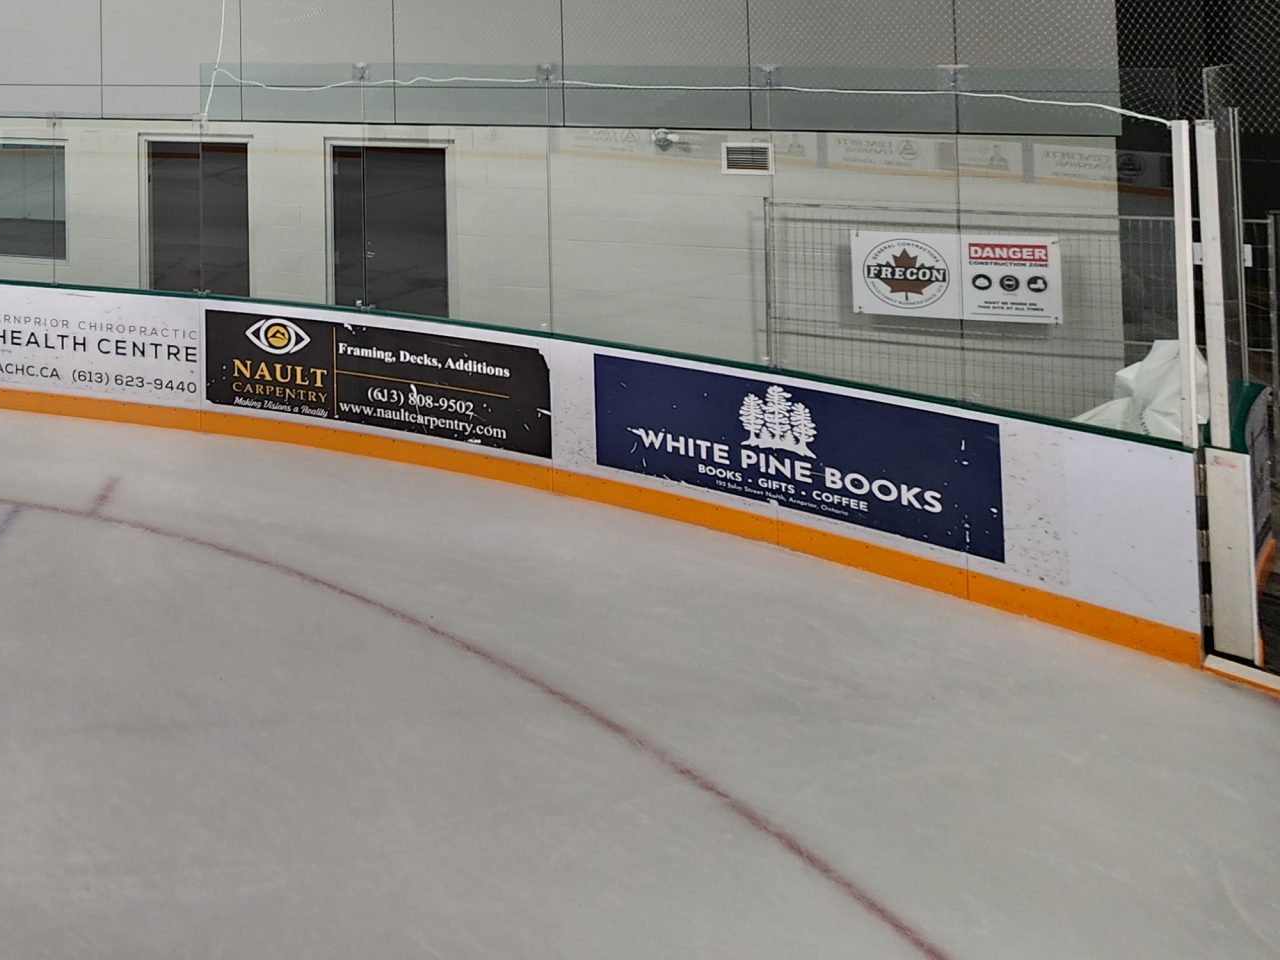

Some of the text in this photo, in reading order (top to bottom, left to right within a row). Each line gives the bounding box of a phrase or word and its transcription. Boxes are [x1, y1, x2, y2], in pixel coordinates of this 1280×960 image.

[970, 246, 1047, 260] DANGER
[869, 266, 945, 282] FRECON
[78, 320, 198, 341] CHIROPRACTIC
[97, 338, 198, 363] CENTRE
[338, 343, 510, 378] Framing, Decks, Additions
[71, 369, 110, 386] (613)
[114, 373, 197, 394] 623-9440
[232, 359, 328, 388] NAULT
[232, 381, 329, 404] CARPENTRY
[367, 386, 475, 416] (613) 808-9502
[234, 396, 261, 409] Making
[301, 405, 329, 418] Reality
[338, 400, 508, 440] www.naultcarpentry.com
[636, 428, 943, 514] WHITE PINE BOOKS
[697, 463, 869, 513] BOOKS GIFTS COFFEE
[744, 485, 764, 496] Street
[820, 504, 849, 516] Ontario
